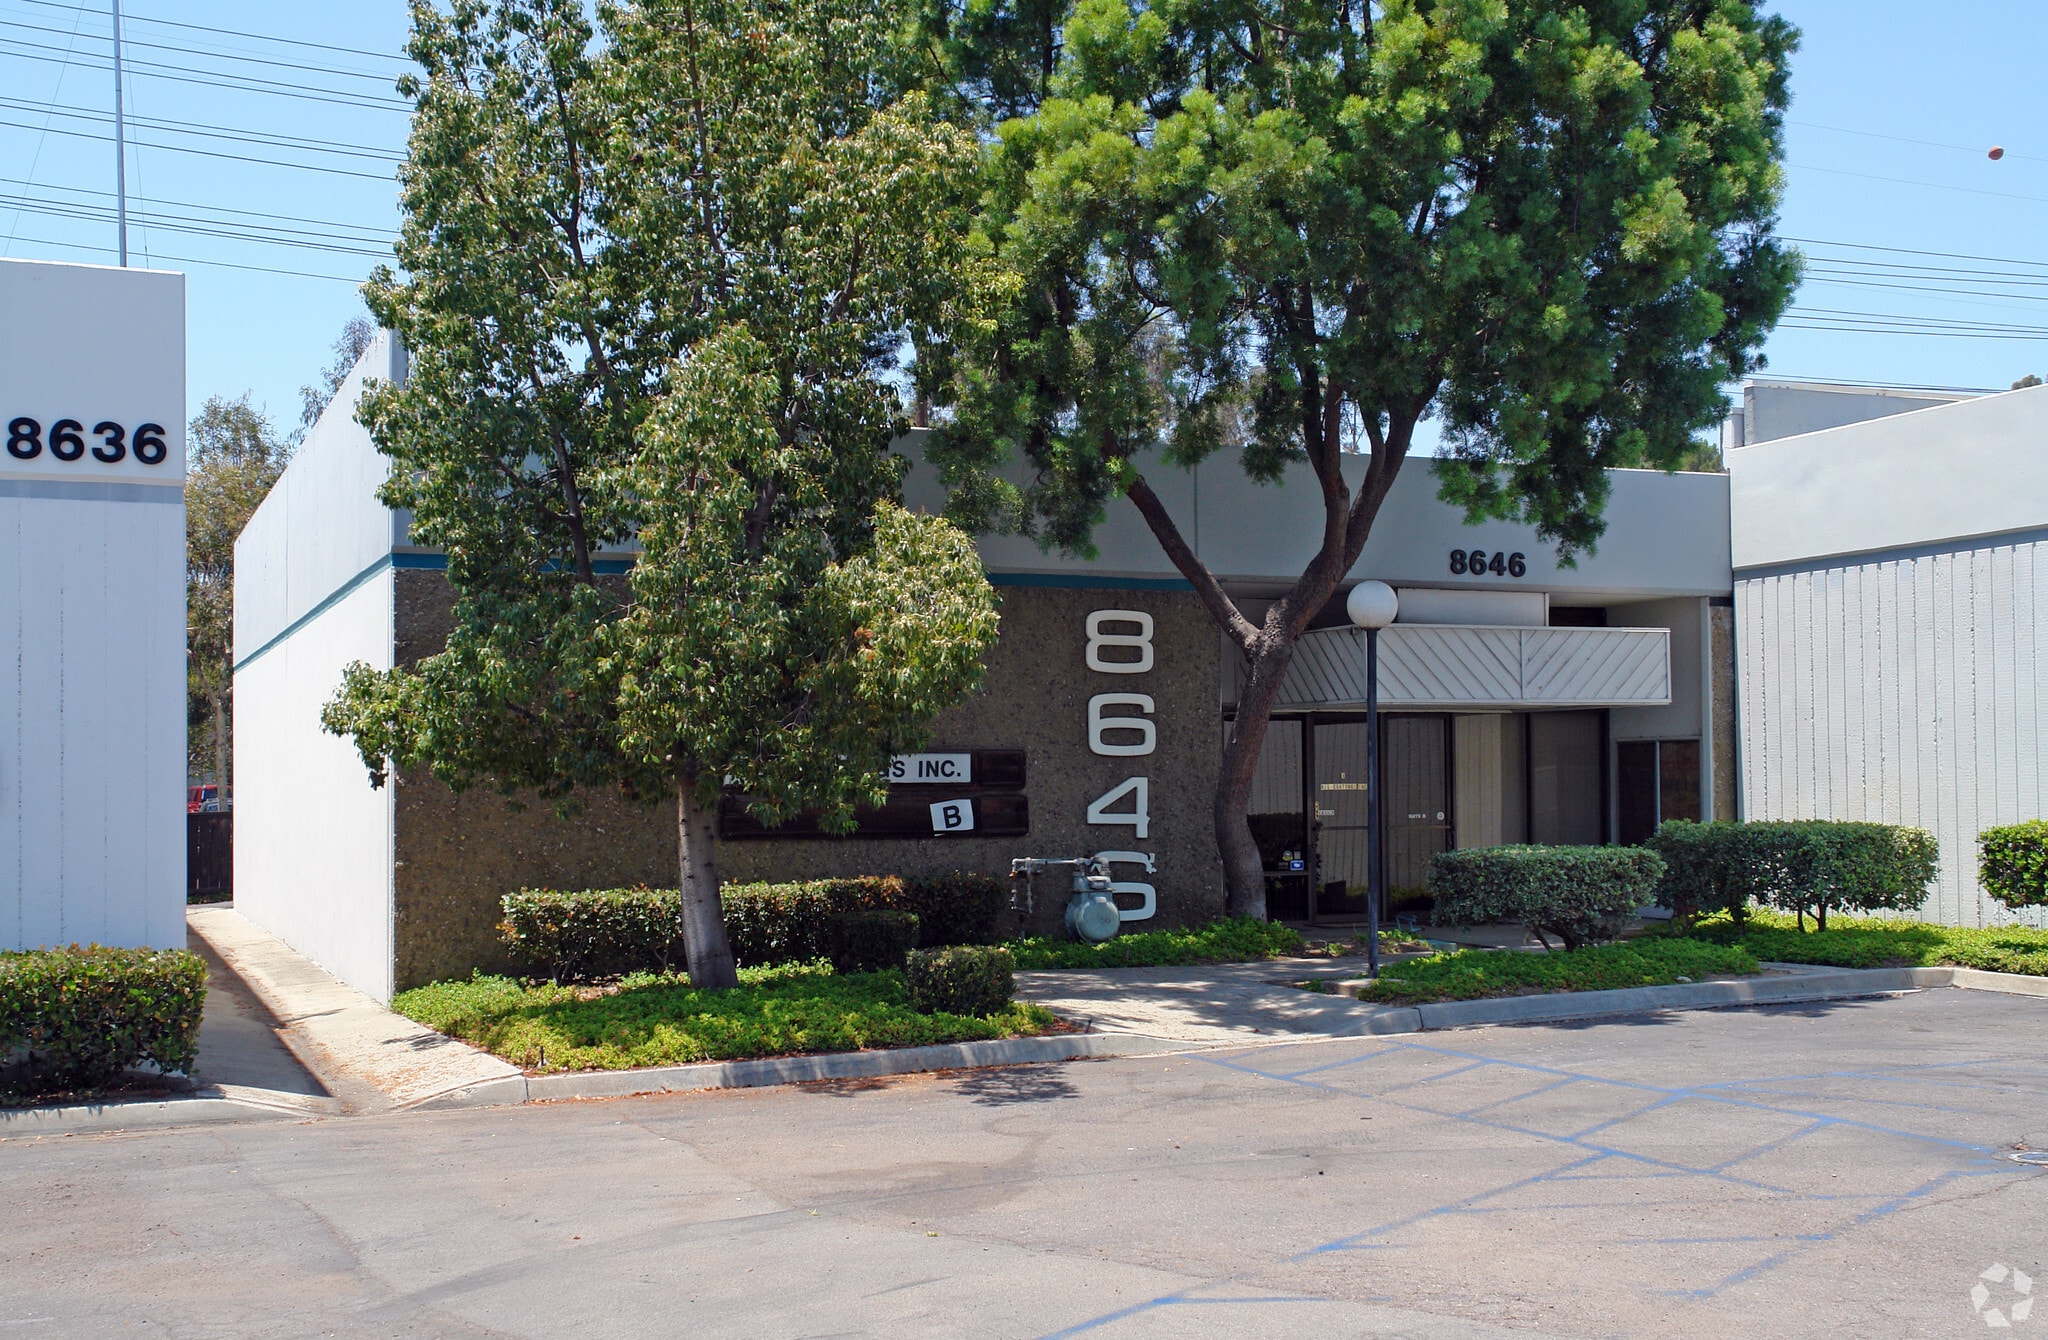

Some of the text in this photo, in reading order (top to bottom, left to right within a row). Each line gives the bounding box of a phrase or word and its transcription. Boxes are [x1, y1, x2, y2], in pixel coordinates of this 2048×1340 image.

[6, 416, 167, 465] 8636
[1450, 549, 1526, 577] 8646
[916, 760, 961, 778] INC.
[942, 805, 962, 829] B
